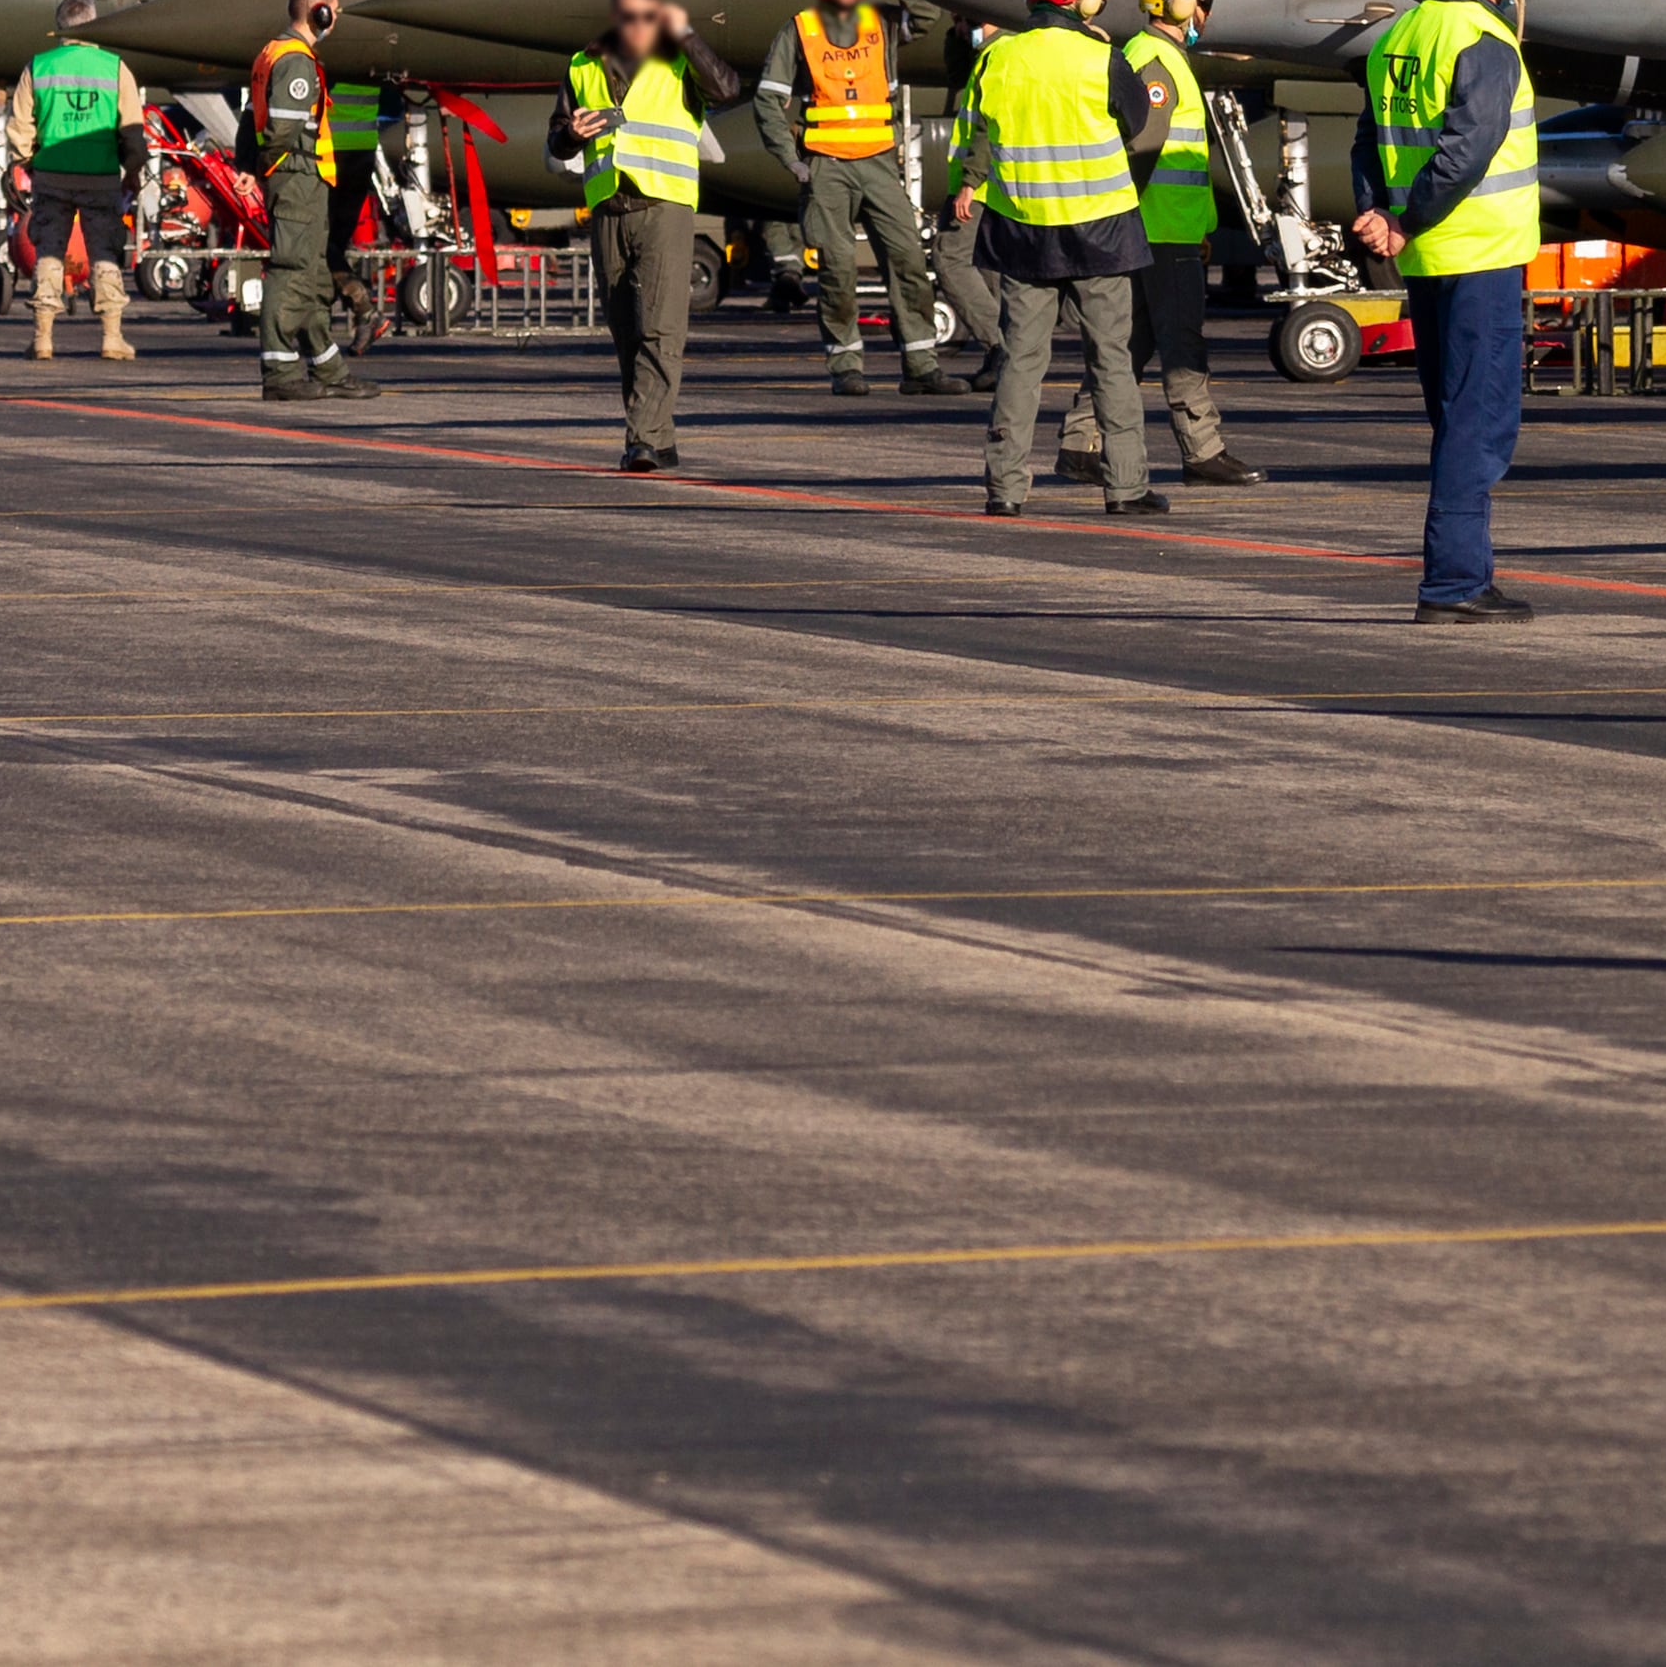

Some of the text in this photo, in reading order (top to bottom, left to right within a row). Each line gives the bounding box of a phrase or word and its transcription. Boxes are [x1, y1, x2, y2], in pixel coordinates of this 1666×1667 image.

[822, 46, 870, 62] ARMT
[53, 90, 99, 111] TLP
[63, 113, 92, 122] STAFF
